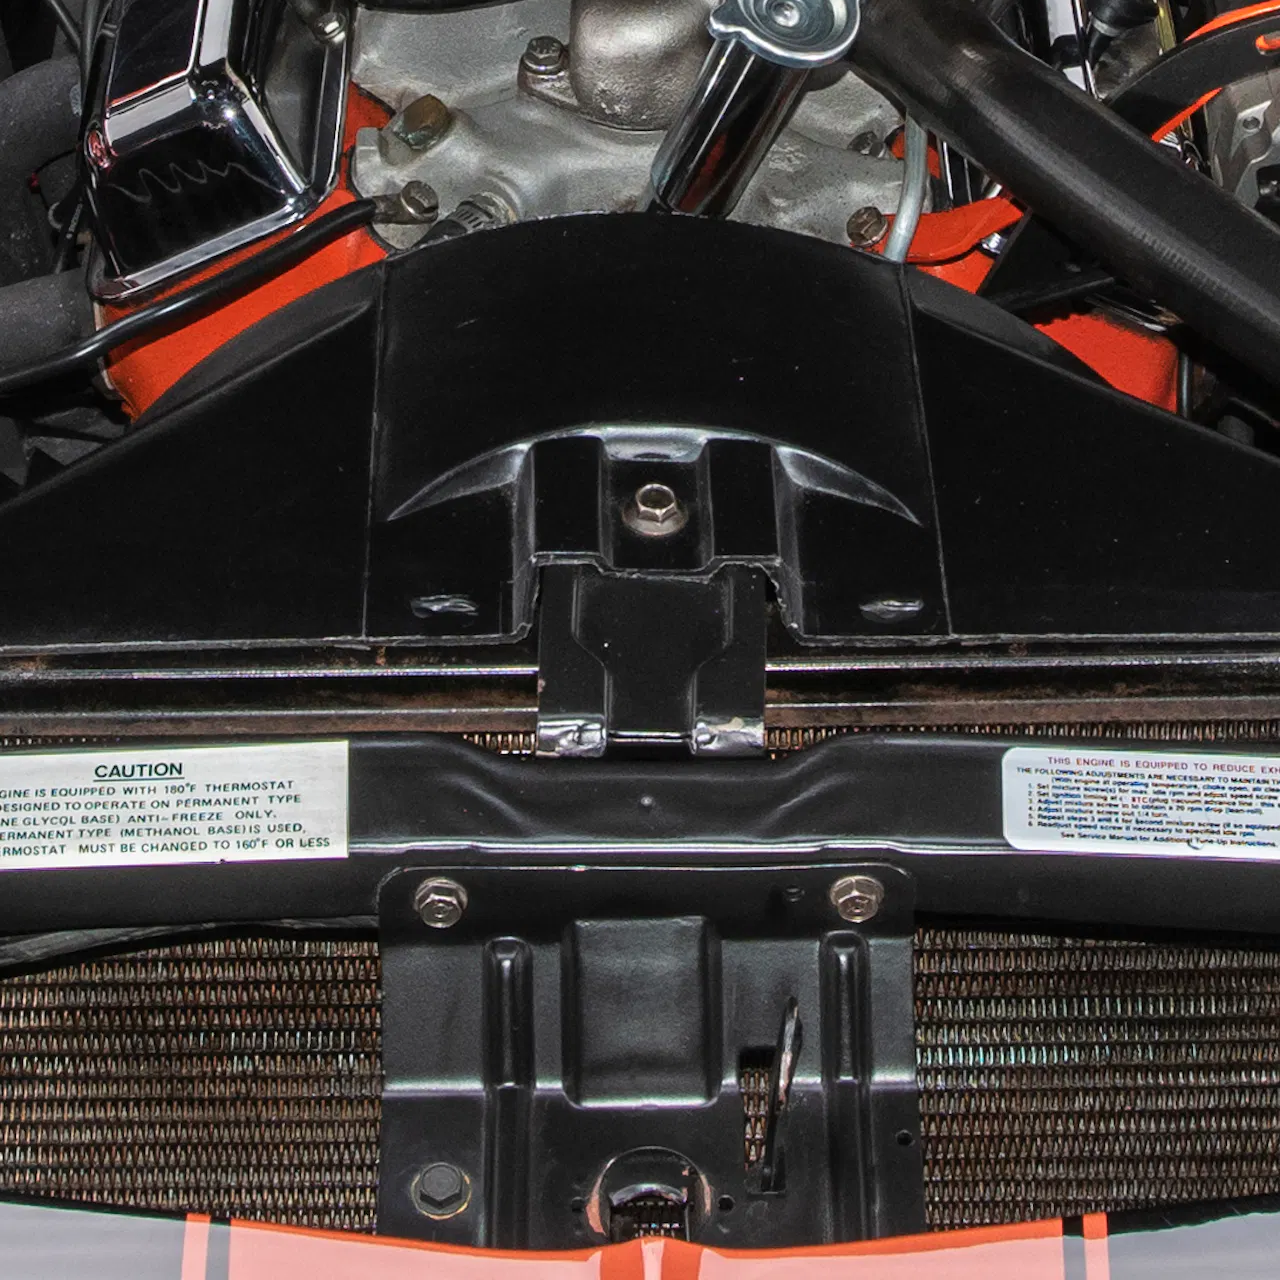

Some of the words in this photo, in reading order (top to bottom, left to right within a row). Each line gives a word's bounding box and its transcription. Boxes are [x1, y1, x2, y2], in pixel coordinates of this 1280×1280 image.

[94, 762, 182, 777] CAUTION
[1048, 756, 1070, 764] THIS
[1076, 758, 1114, 766] ENGINE
[1135, 760, 1188, 769] EQUIPPED
[1212, 763, 1255, 773] REDUCE
[1034, 768, 1083, 776] FOLLOWING
[1086, 770, 1144, 778] ADJUSTMENTS
[1166, 774, 1214, 782] NECESSARY
[35, 789, 45, 797] IS
[51, 787, 115, 797] EQUIPPED
[122, 785, 156, 795] WITH
[206, 780, 293, 792] THERMOSTAT
[1112, 780, 1148, 788] operating
[65, 801, 81, 811] TO
[84, 799, 145, 810] OPERATE
[151, 799, 168, 808] ON
[176, 796, 258, 807] PERMANENT
[268, 794, 300, 803] TYPE
[22, 815, 75, 826] GLYCOL
[81, 814, 119, 825] BASE)
[235, 810, 276, 819] ONLY.
[79, 828, 110, 838] TYPE
[120, 826, 199, 837] (METHANOL
[208, 825, 245, 835] BASE)
[249, 824, 259, 833] IS
[78, 843, 114, 854] MUST
[120, 843, 135, 852] BE
[141, 840, 207, 852] CHANGED
[214, 840, 229, 849] TO
[276, 838, 293, 847] OR
[299, 837, 329, 847] LESS
